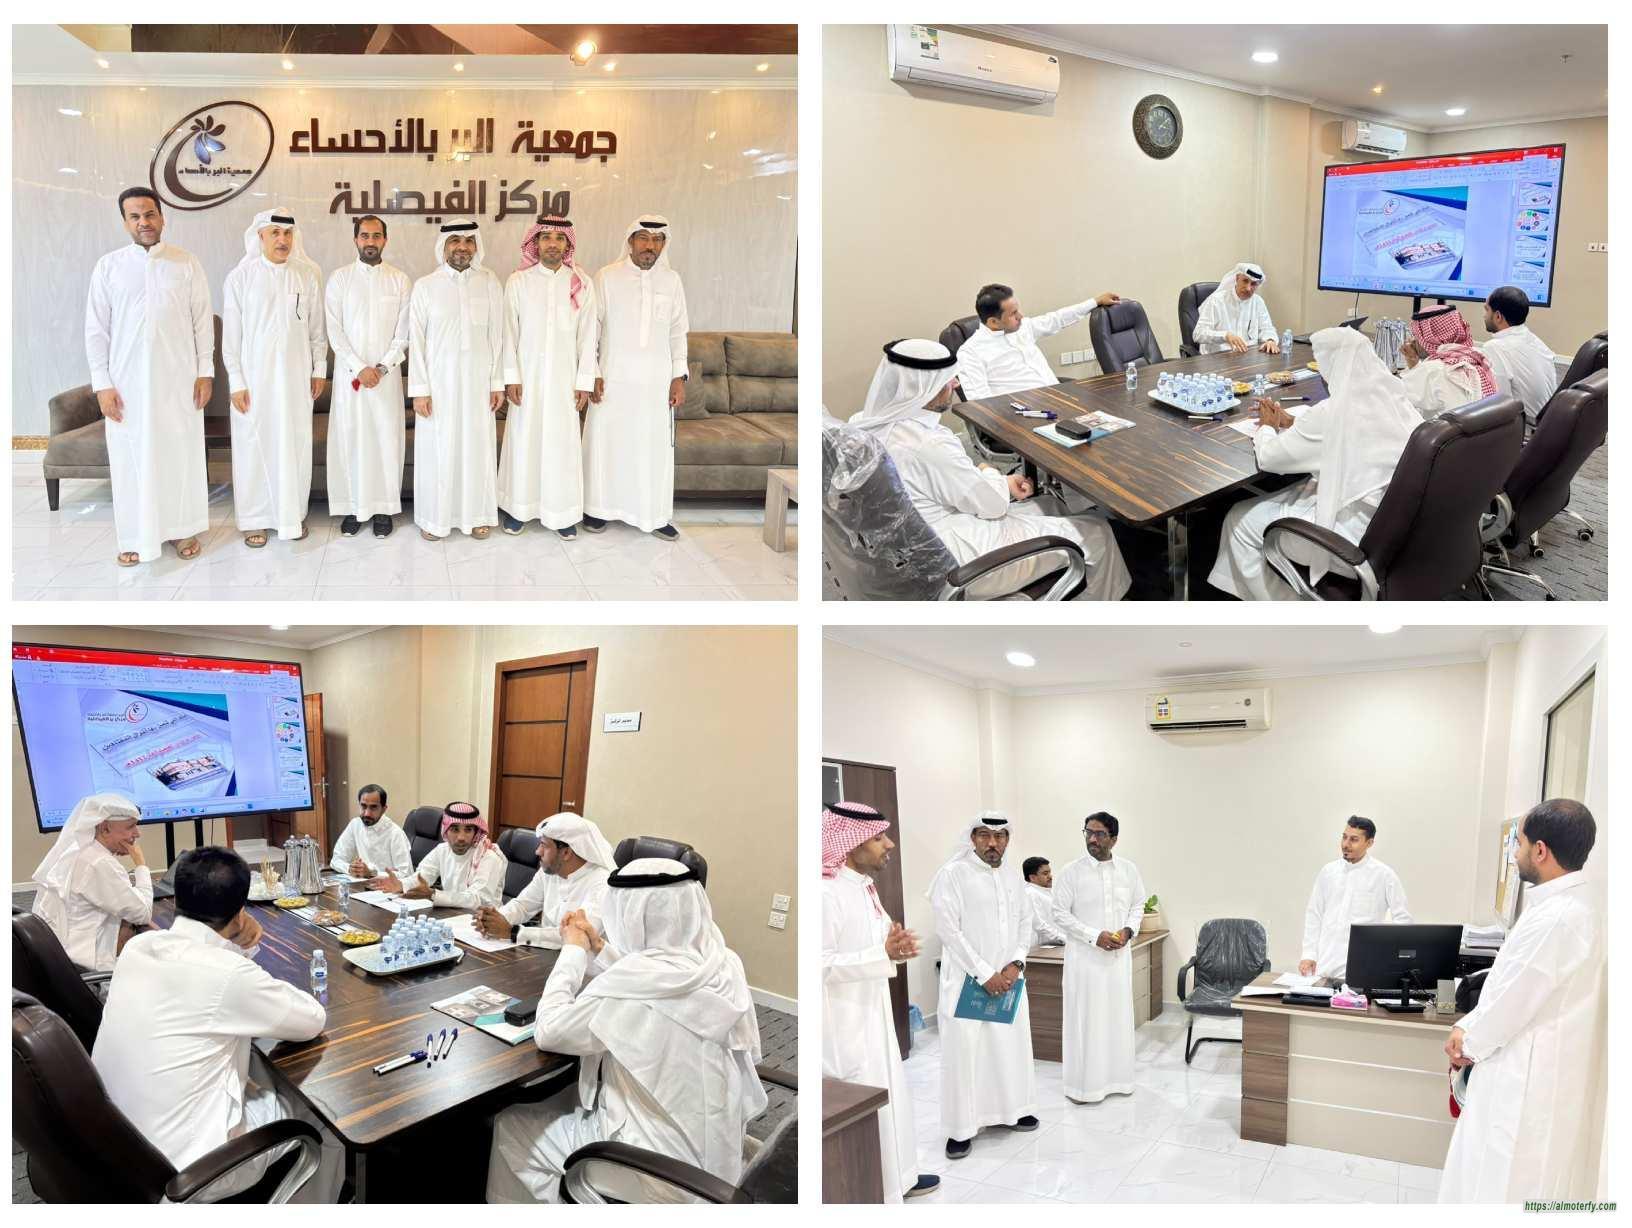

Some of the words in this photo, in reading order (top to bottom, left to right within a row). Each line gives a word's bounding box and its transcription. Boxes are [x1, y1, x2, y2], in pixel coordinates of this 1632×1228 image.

[289, 117, 438, 162] بالأحساء
[447, 117, 495, 162] البر
[511, 119, 618, 168] جمعية
[329, 179, 486, 223] الفيصلية
[495, 179, 571, 222] مركز
